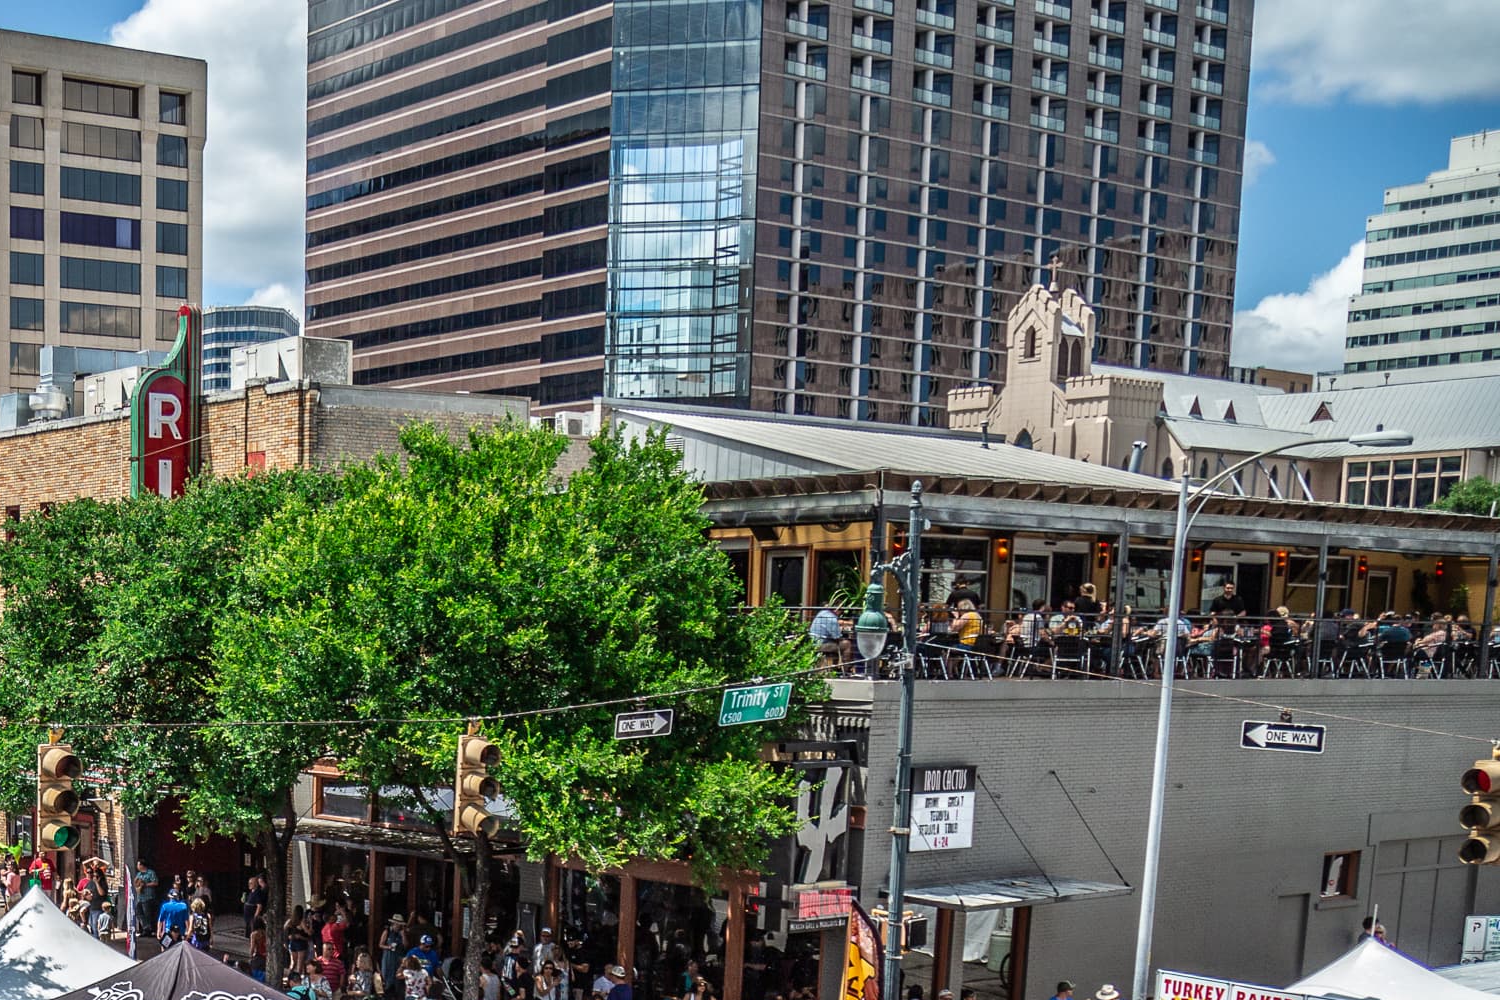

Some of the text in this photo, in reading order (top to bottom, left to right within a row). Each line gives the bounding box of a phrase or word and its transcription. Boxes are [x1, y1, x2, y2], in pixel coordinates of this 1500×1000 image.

[731, 686, 785, 709] Trinity ST
[728, 712, 742, 723] 500
[764, 708, 780, 719] 600
[621, 718, 655, 731] ONE WAY
[1266, 730, 1315, 744] ONE WAY
[924, 769, 967, 791] IRON CACTUS
